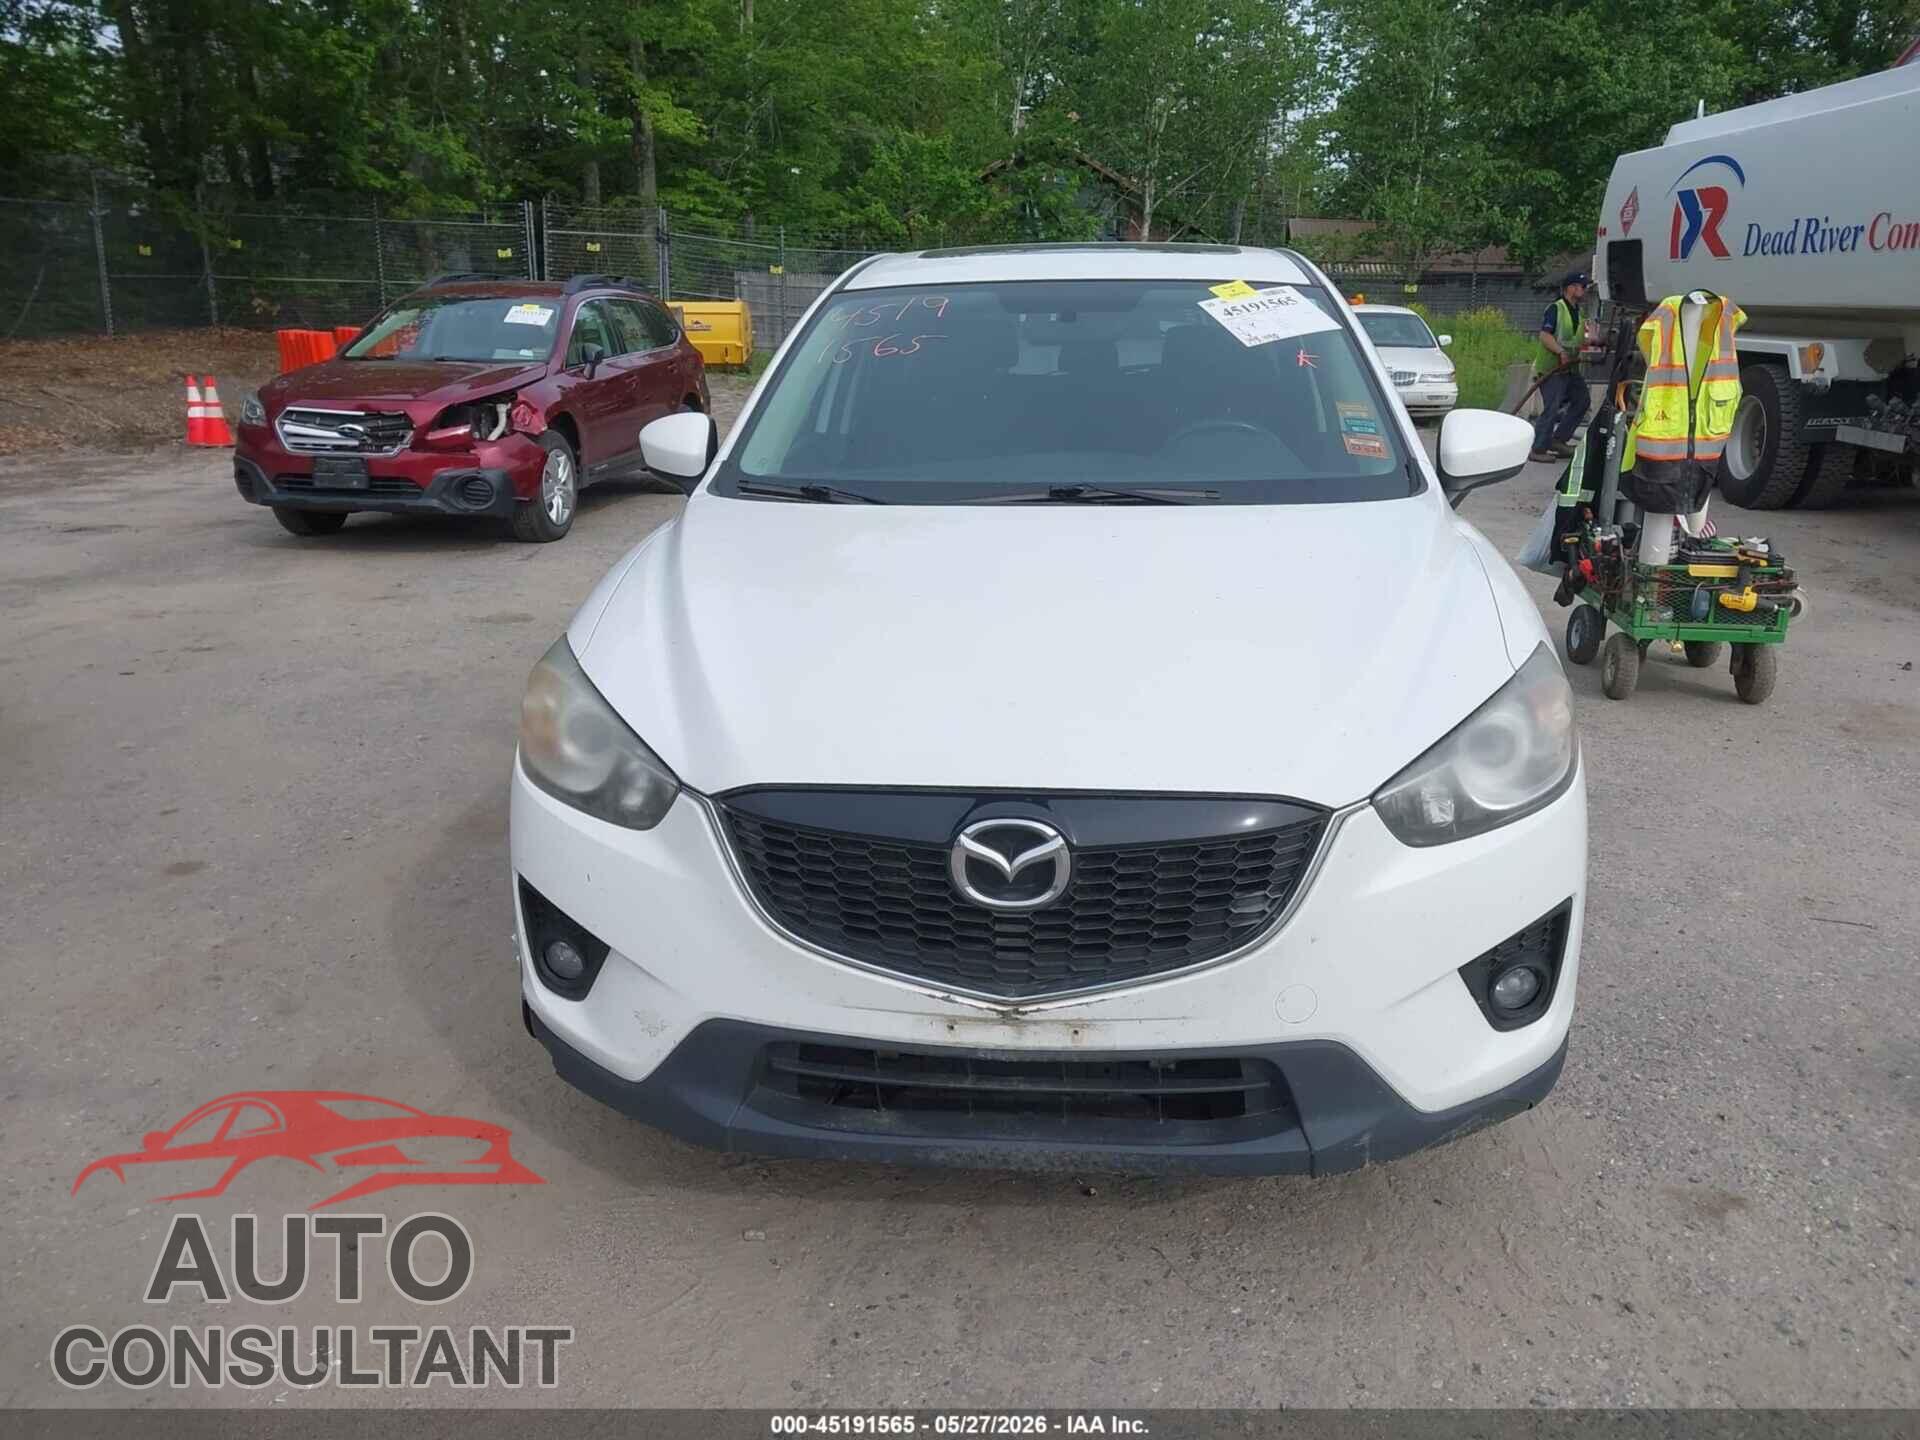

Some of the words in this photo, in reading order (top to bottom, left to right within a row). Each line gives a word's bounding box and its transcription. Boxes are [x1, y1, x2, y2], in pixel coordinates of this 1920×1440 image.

[1743, 219, 1800, 256] Dead
[1801, 216, 1864, 254] River
[1224, 296, 1298, 317] 45191565
